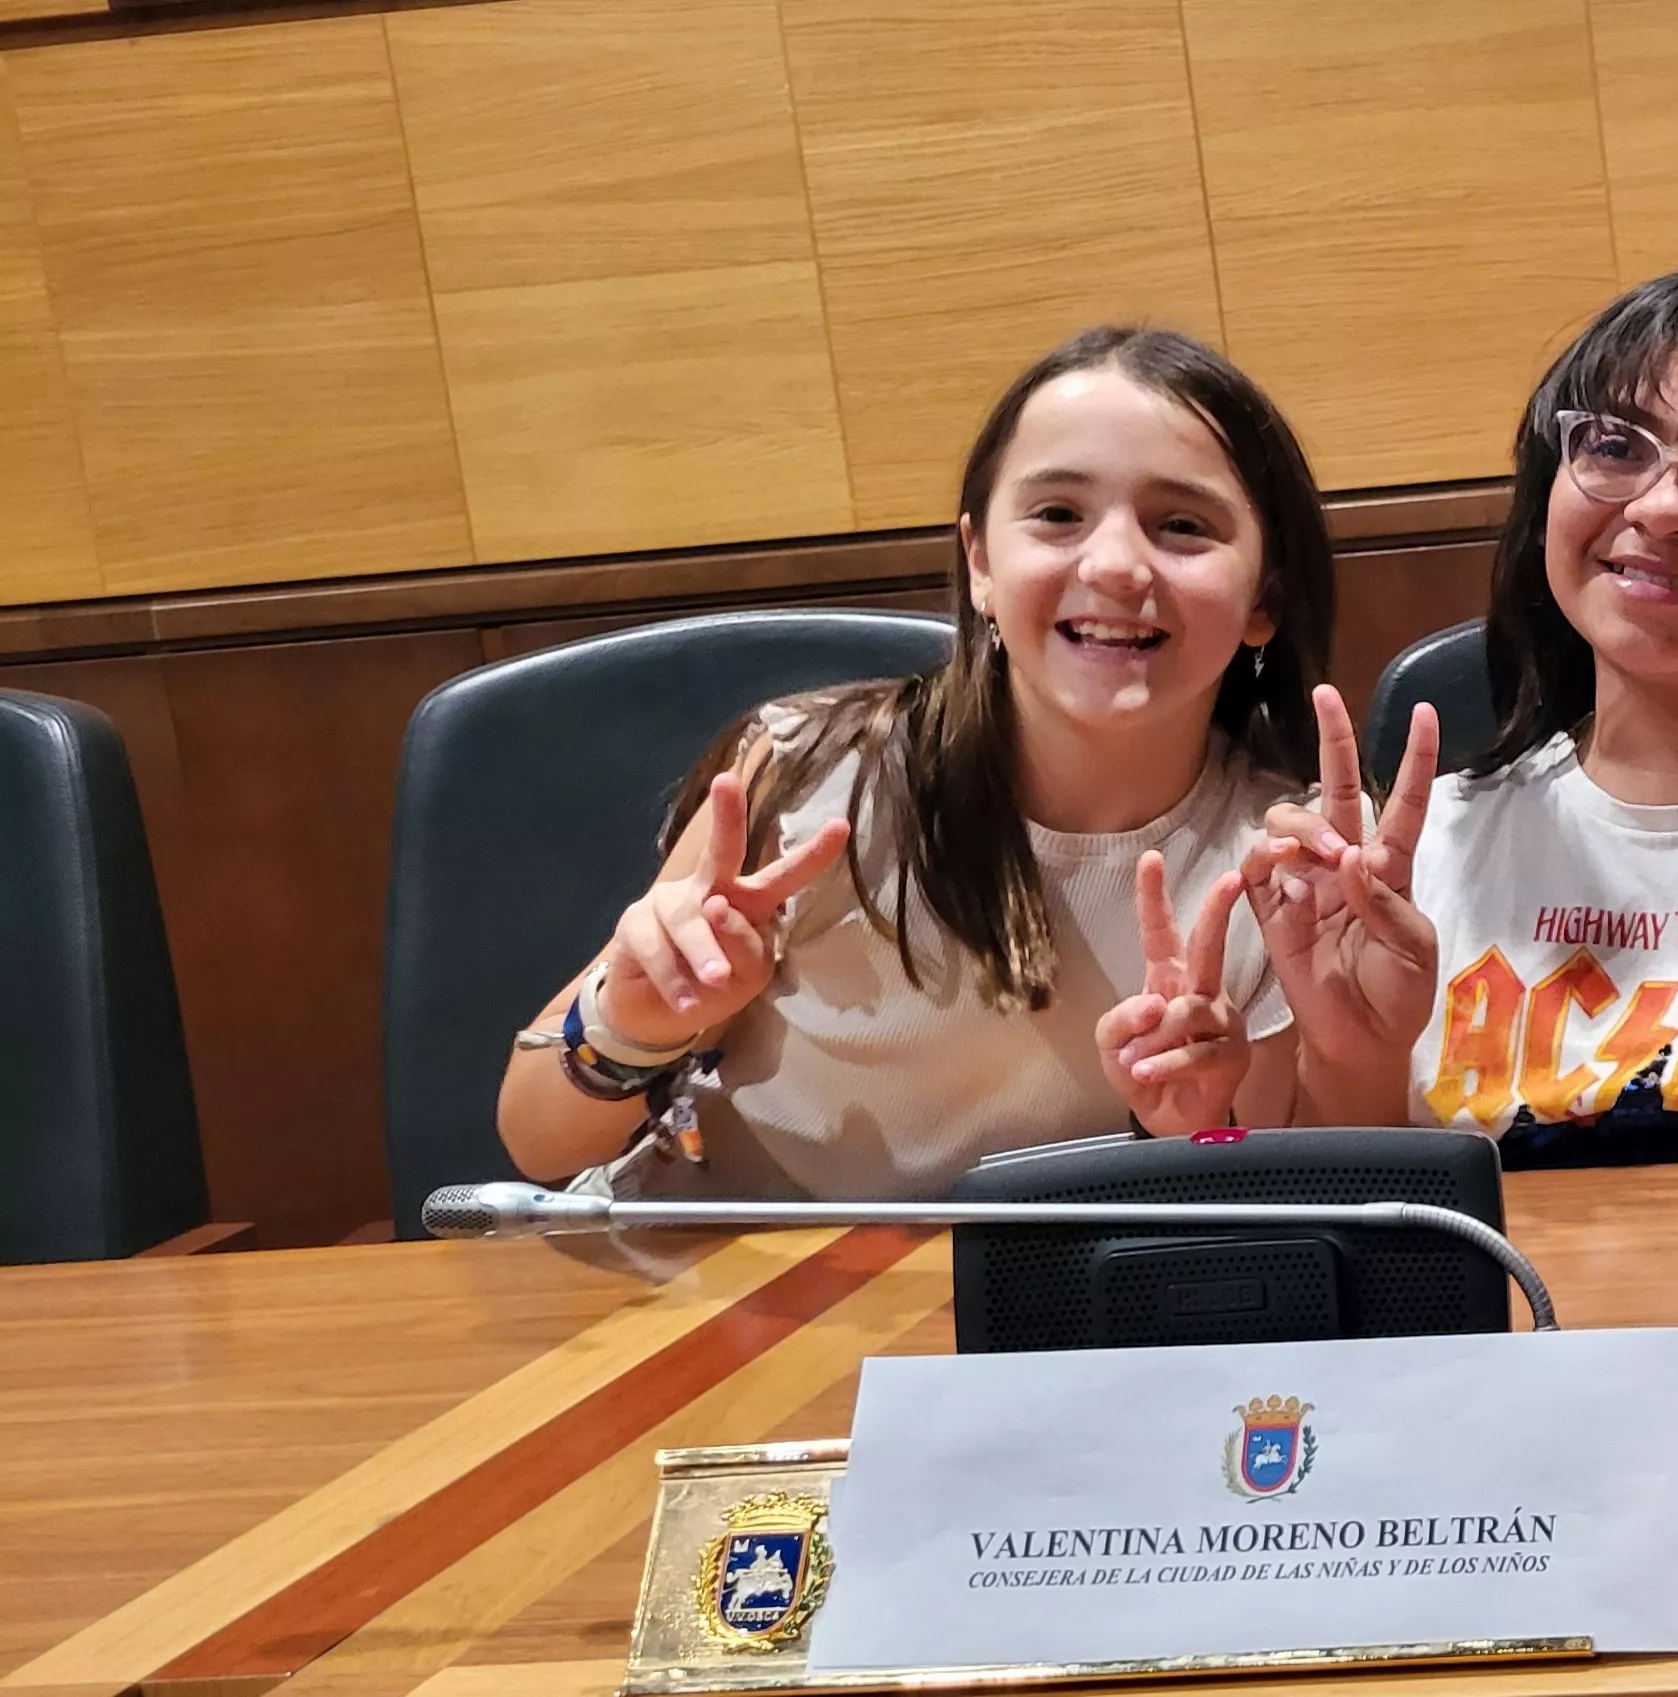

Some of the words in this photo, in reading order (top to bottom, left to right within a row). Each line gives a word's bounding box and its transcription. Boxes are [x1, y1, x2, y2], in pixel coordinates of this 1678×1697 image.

[1534, 905, 1670, 951] HIGHWAY
[970, 1527, 1186, 1560] VALENTINA
[1196, 1520, 1366, 1552] MORENO
[1376, 1506, 1558, 1548] BELTRÁN
[968, 1568, 1087, 1589] CONSEJERA
[1090, 1567, 1122, 1586] DE
[1124, 1567, 1151, 1585] LA
[1157, 1564, 1237, 1584] CIUDAD
[1240, 1563, 1270, 1581] DE
[1274, 1561, 1315, 1580] LAS
[1317, 1557, 1383, 1579] NIÑAS
[1387, 1558, 1402, 1577] Y
[1403, 1557, 1435, 1576] DE
[1437, 1556, 1479, 1575] LOS
[1480, 1552, 1551, 1574] NIÑOS
